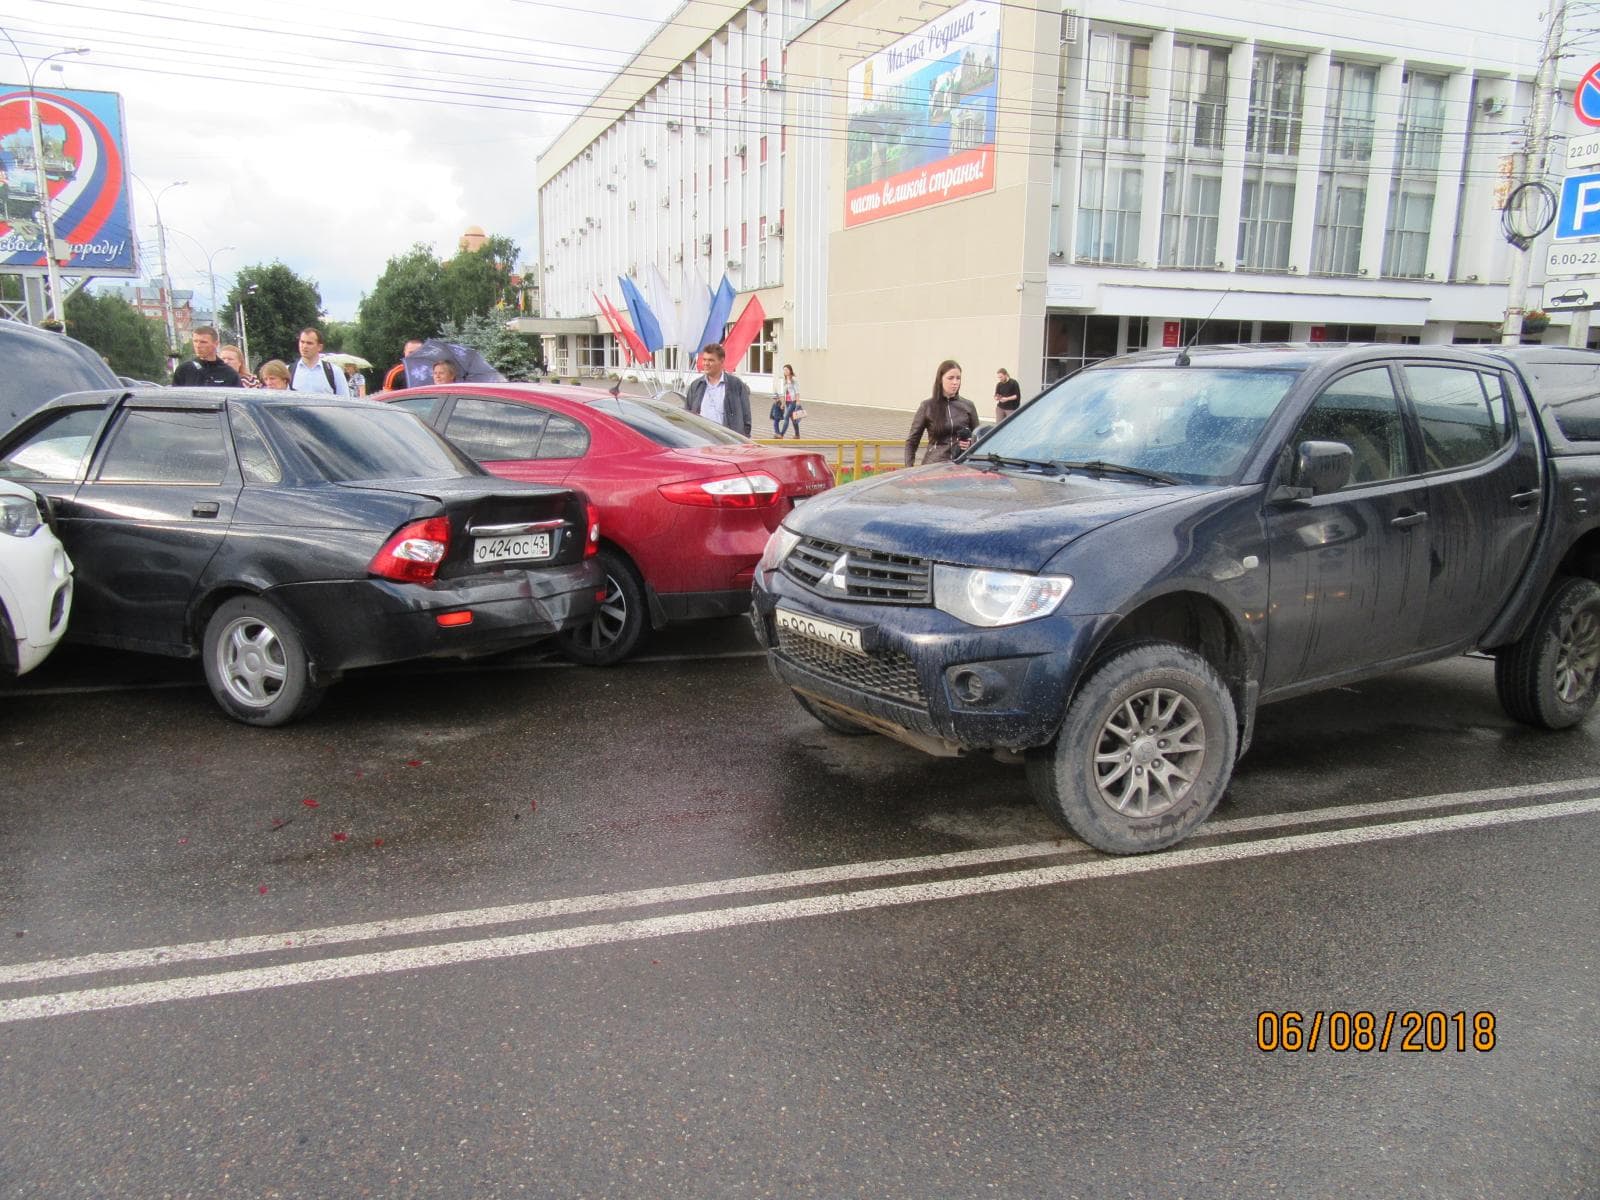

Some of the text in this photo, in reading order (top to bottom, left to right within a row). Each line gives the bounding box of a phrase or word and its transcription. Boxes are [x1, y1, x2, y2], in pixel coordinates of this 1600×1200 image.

[886, 40, 925, 74] Малая
[927, 11, 975, 52] Родина
[850, 152, 987, 215] часть великой страны!
